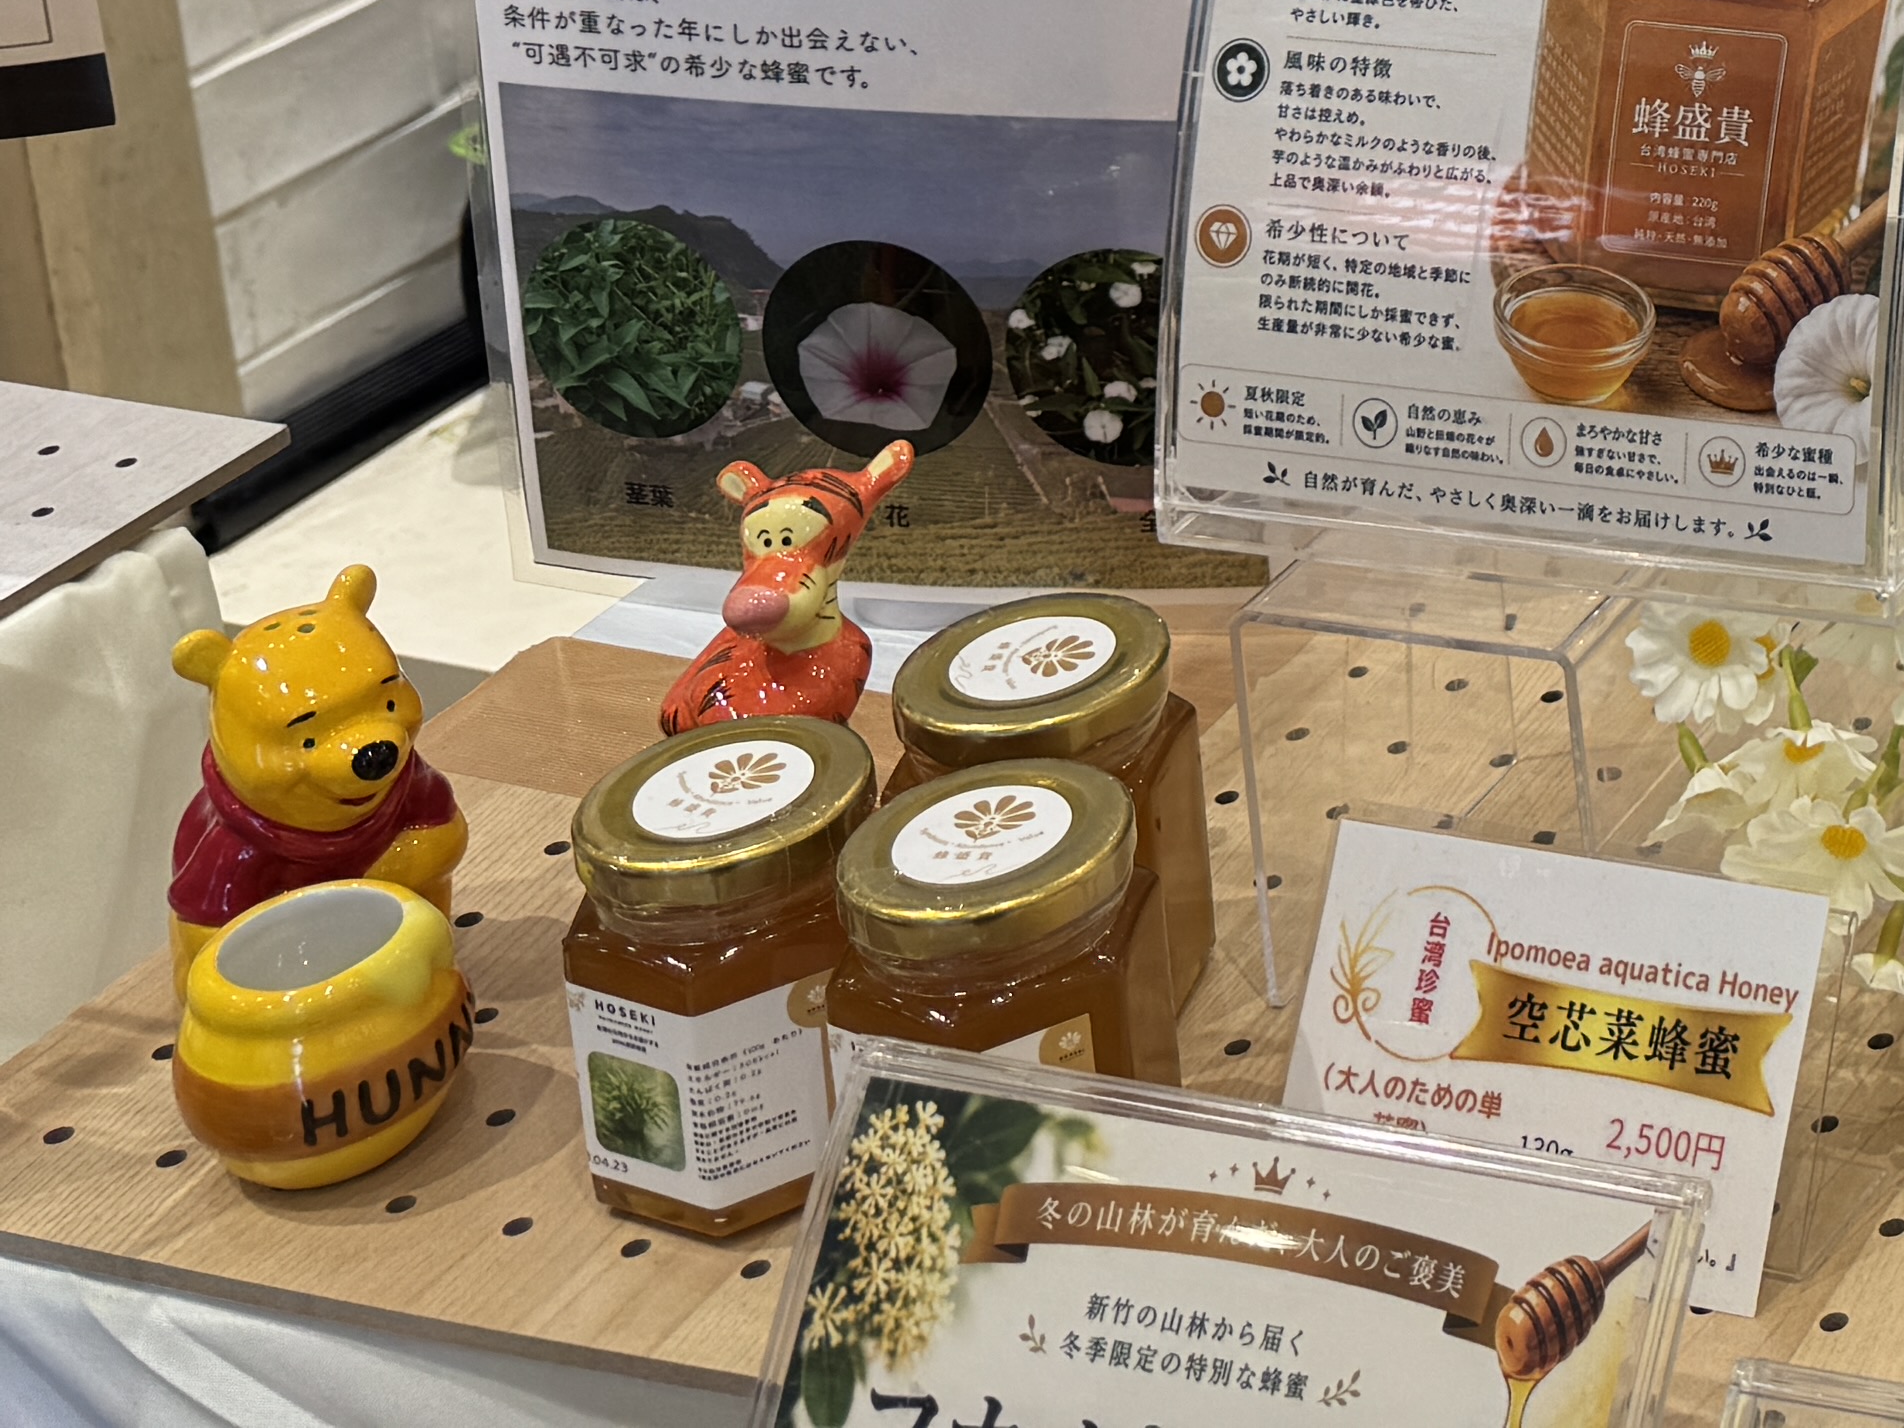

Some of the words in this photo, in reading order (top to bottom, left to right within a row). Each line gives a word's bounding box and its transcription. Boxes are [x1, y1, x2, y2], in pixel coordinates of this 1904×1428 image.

[503, 5, 919, 56] 条件が重なった年にしか出会えない、
[1284, 51, 1392, 79] 風味の特徴
[1280, 81, 1440, 109] 落ち着きのある味わいで、
[1632, 97, 1754, 147] 蜂盛貴
[1658, 163, 1716, 177] HOSEKI
[1266, 219, 1410, 251] 希少性について
[1245, 386, 1305, 407] 夏秋限定
[1407, 404, 1482, 427] 自然の恵み
[624, 480, 674, 508] 茎葉
[1303, 469, 1737, 541] 自然が育んだ、やさしく奥深い一滴をお届けします。
[885, 503, 910, 528] 花
[1486, 931, 1591, 973] Ipomoea
[1599, 953, 1710, 994] aquatica
[1718, 971, 1799, 1012] Honey
[594, 999, 656, 1026] HOSEKI
[1502, 992, 1740, 1080] 空芯菜蜂蜜
[301, 992, 475, 1146] HUNN
[1606, 1118, 1726, 1171] 2,500円
[1085, 1293, 1304, 1356] 新竹の山林から届く
[1060, 1331, 1308, 1400] 冬季限定の特別な蜂蜜
